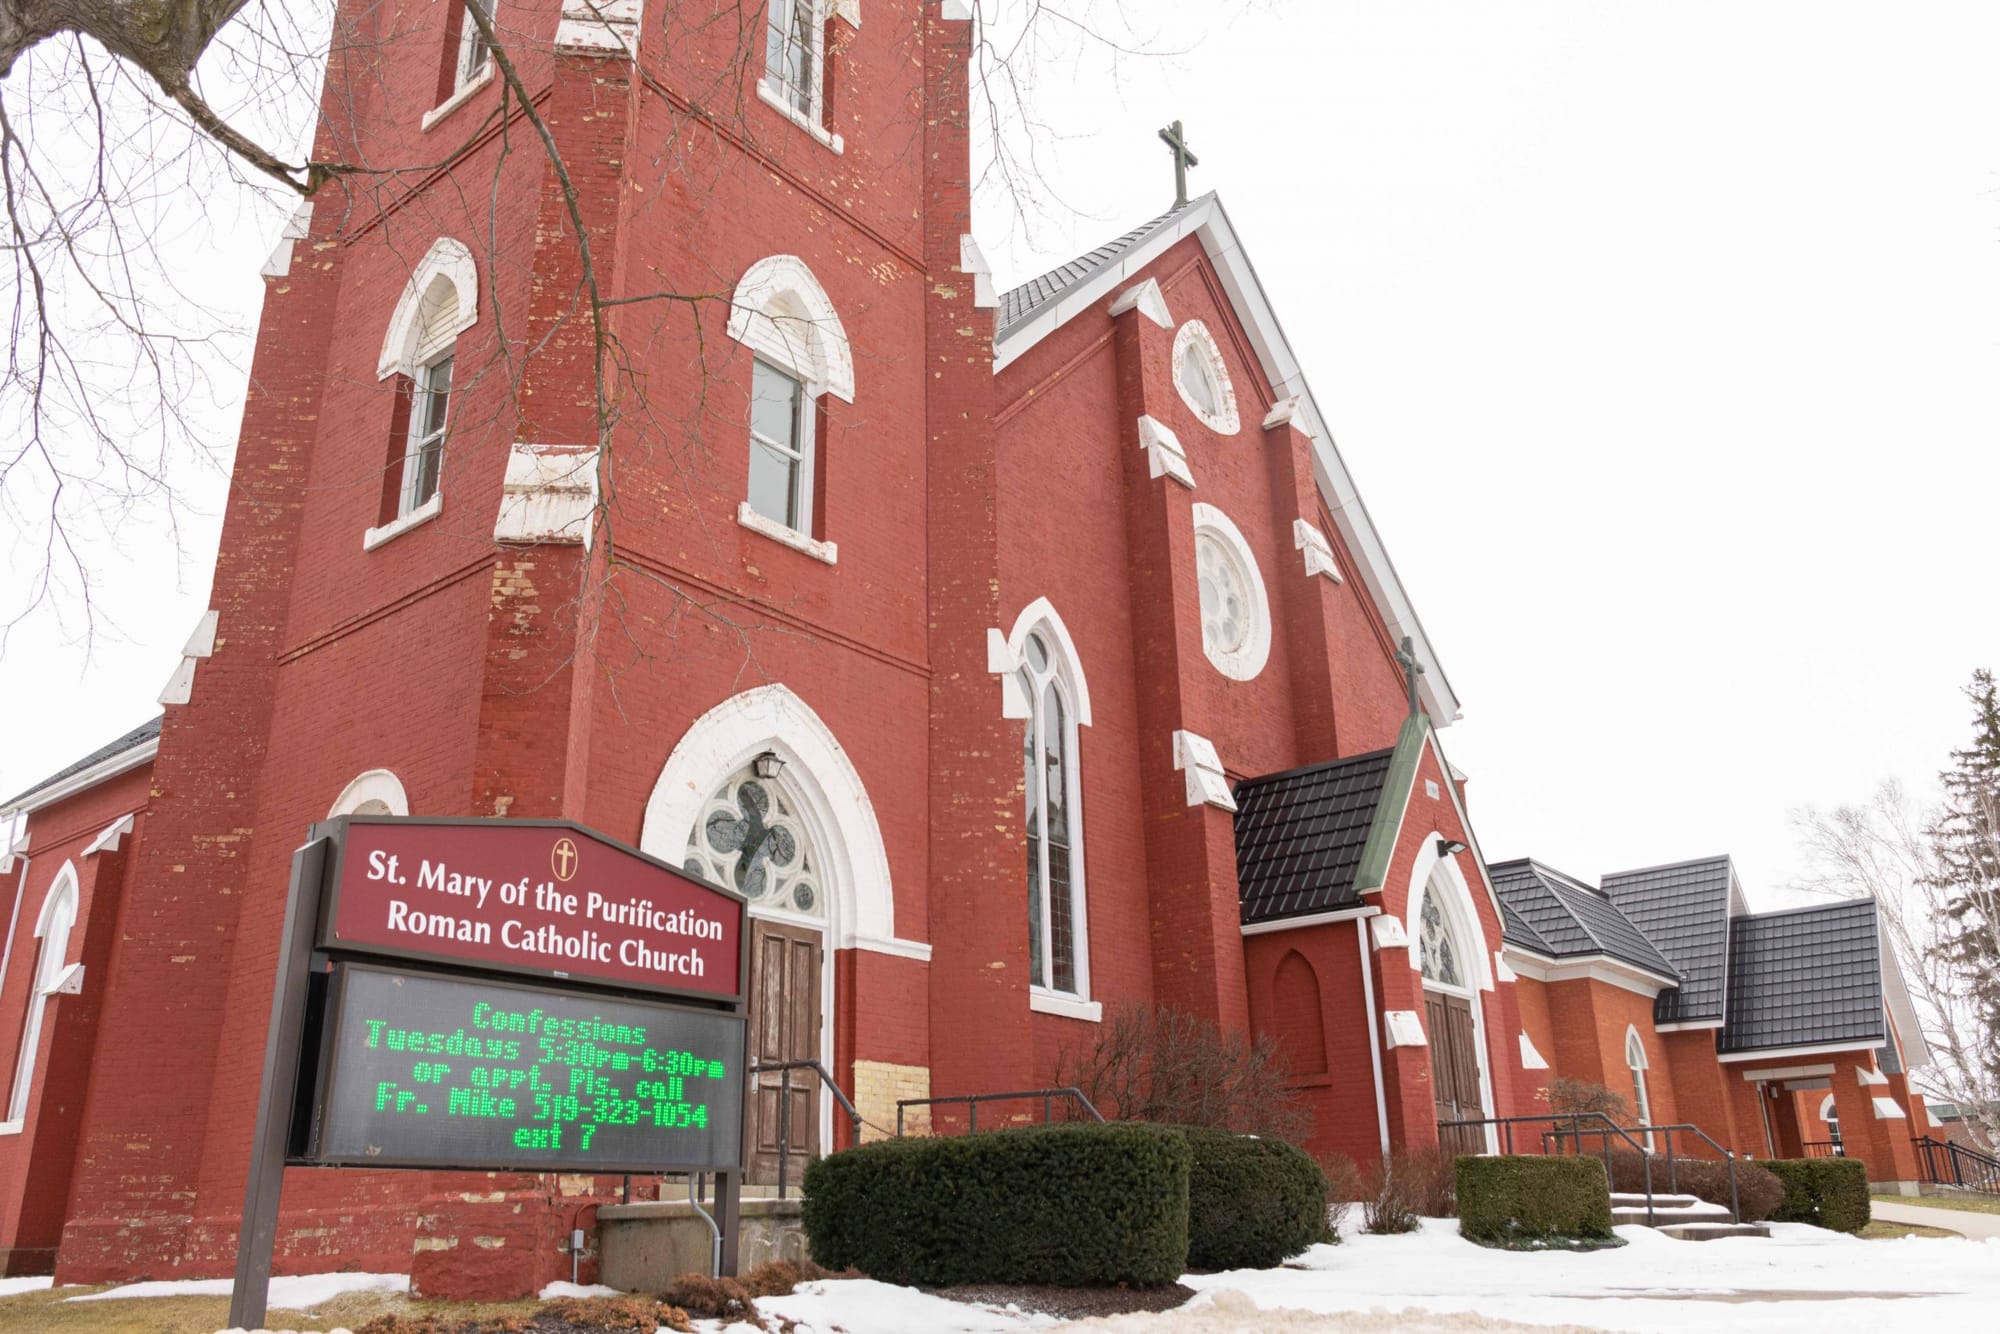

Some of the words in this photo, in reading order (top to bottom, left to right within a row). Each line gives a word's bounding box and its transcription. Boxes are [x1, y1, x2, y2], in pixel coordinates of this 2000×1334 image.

[367, 850, 406, 885] St.
[417, 860, 492, 909] Mary
[500, 877, 529, 906] of
[536, 881, 578, 915] the
[586, 891, 722, 941] Purification
[387, 900, 491, 944] Roman
[501, 920, 611, 963] Catholic
[619, 939, 704, 976] Church
[473, 1002, 646, 1045] Confessions
[365, 1019, 520, 1060] Tuesdays
[538, 1037, 725, 1079] 5:30pm-6:30pm
[413, 1061, 451, 1084] or
[471, 1064, 551, 1091] appt.
[569, 1068, 620, 1096] Pls.
[635, 1076, 684, 1101] call
[375, 1082, 428, 1113] Fr.
[449, 1087, 516, 1118] Mike
[533, 1093, 708, 1129] 519-323-1054
[513, 1122, 562, 1149] ext
[581, 1123, 597, 1150] 7
